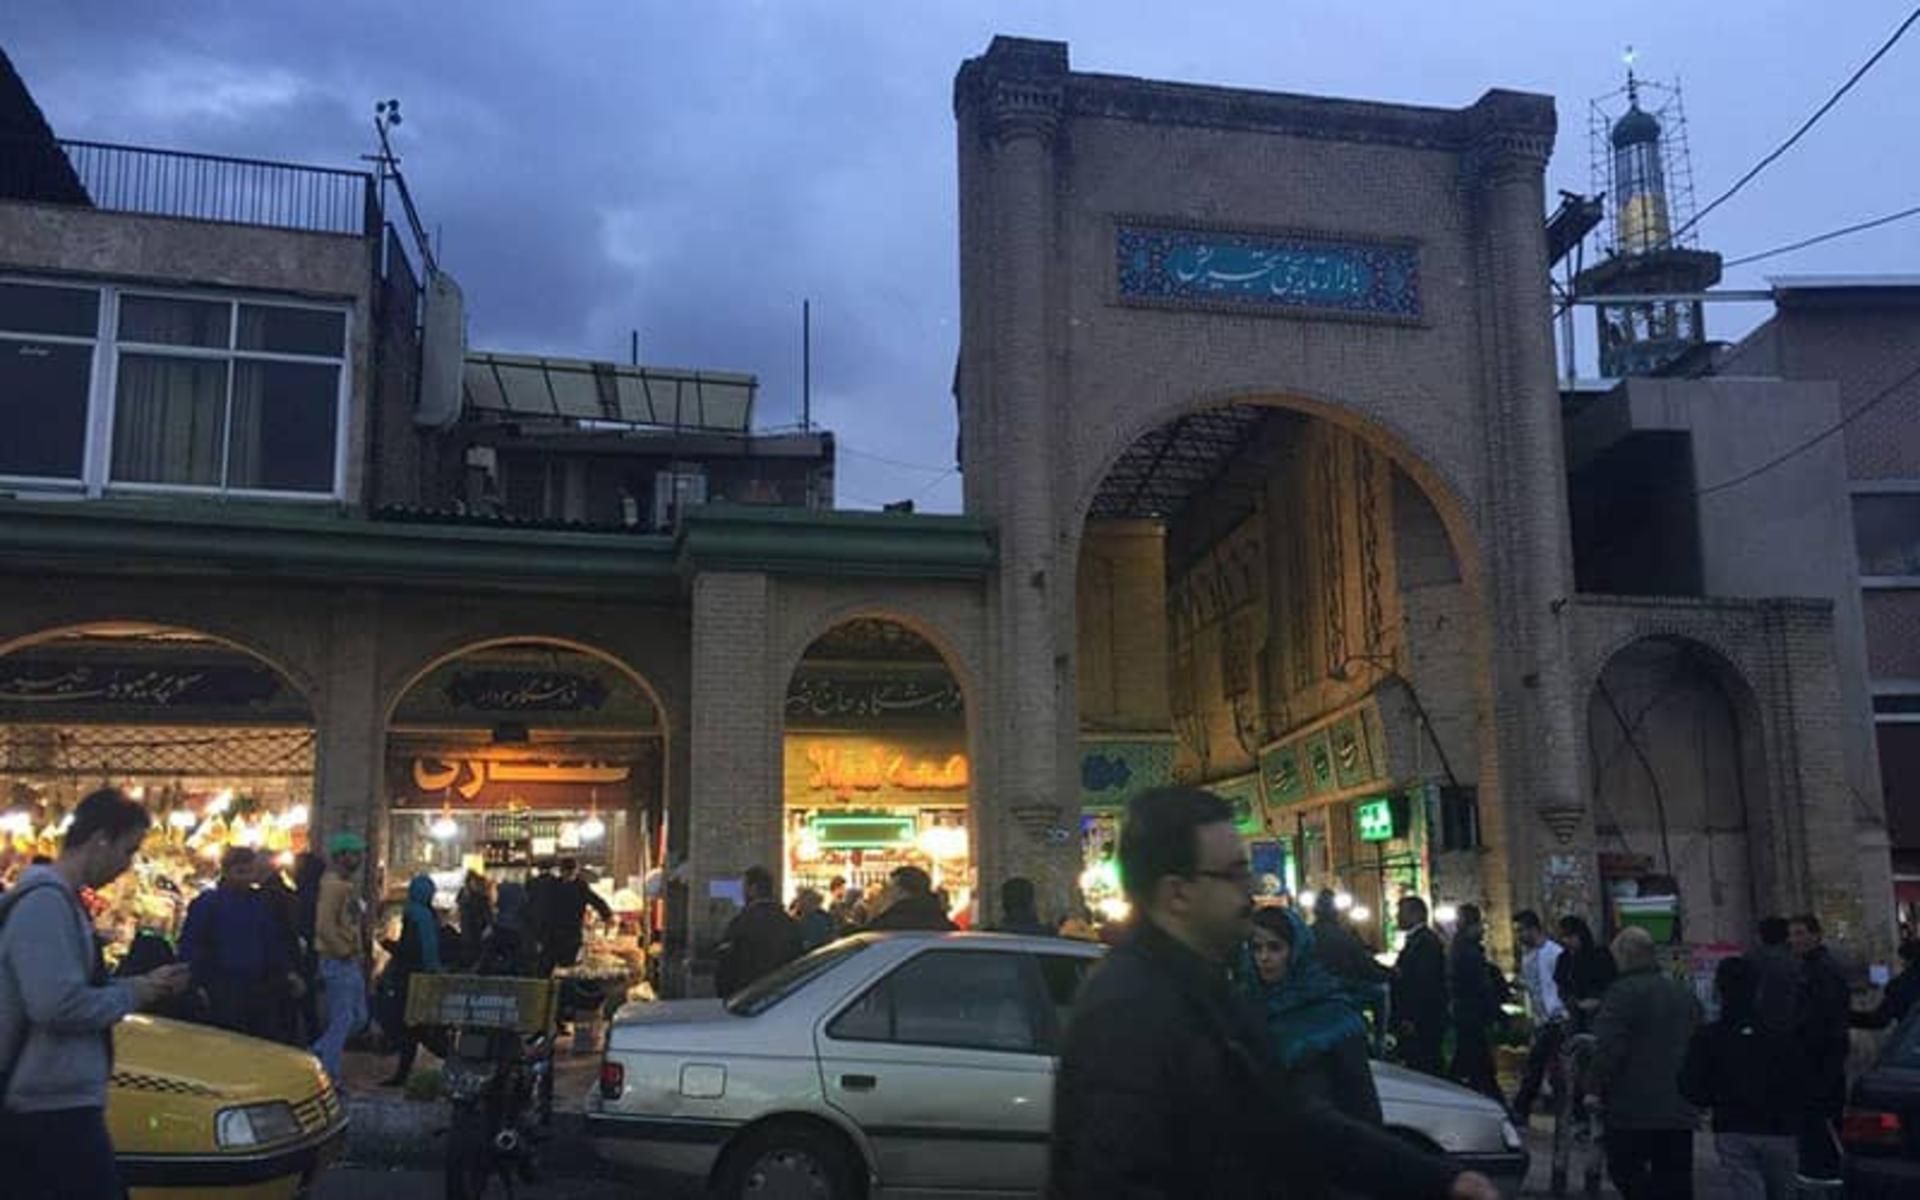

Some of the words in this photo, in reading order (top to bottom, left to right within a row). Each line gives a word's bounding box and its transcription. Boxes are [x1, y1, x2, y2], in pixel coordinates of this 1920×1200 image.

[1176, 245, 1280, 289] تجریش
[1270, 255, 1327, 295] تاریخی
[1323, 257, 1361, 293] بازار
